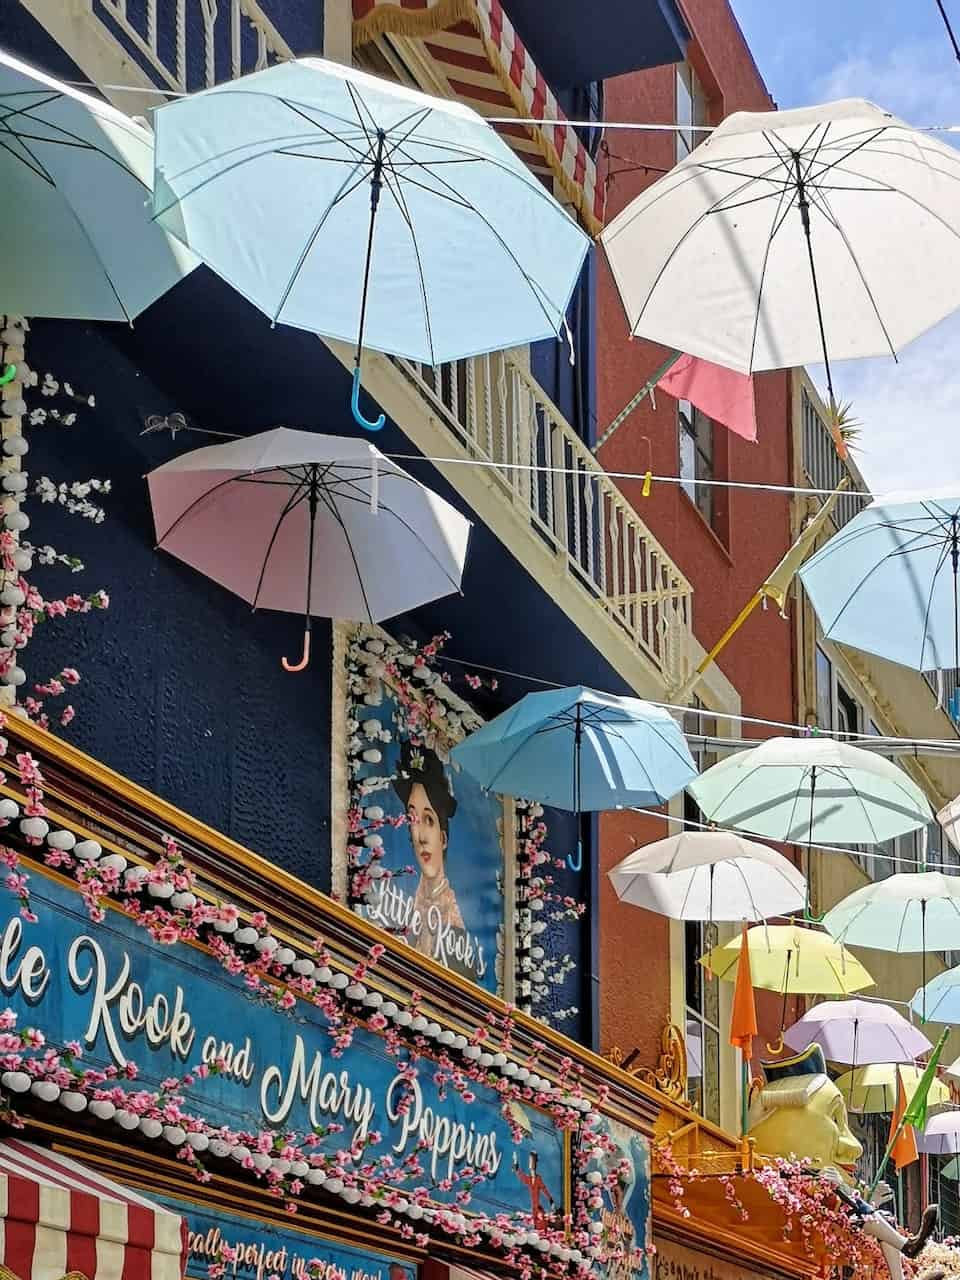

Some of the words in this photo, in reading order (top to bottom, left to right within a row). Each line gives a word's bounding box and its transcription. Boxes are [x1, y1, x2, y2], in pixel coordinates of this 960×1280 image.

[367, 879, 422, 935] Little
[428, 905, 487, 976] Kook's
[68, 936, 195, 1068] Kook
[202, 1036, 254, 1080] and
[261, 1035, 374, 1161] Mary
[386, 1073, 501, 1181] Poppins
